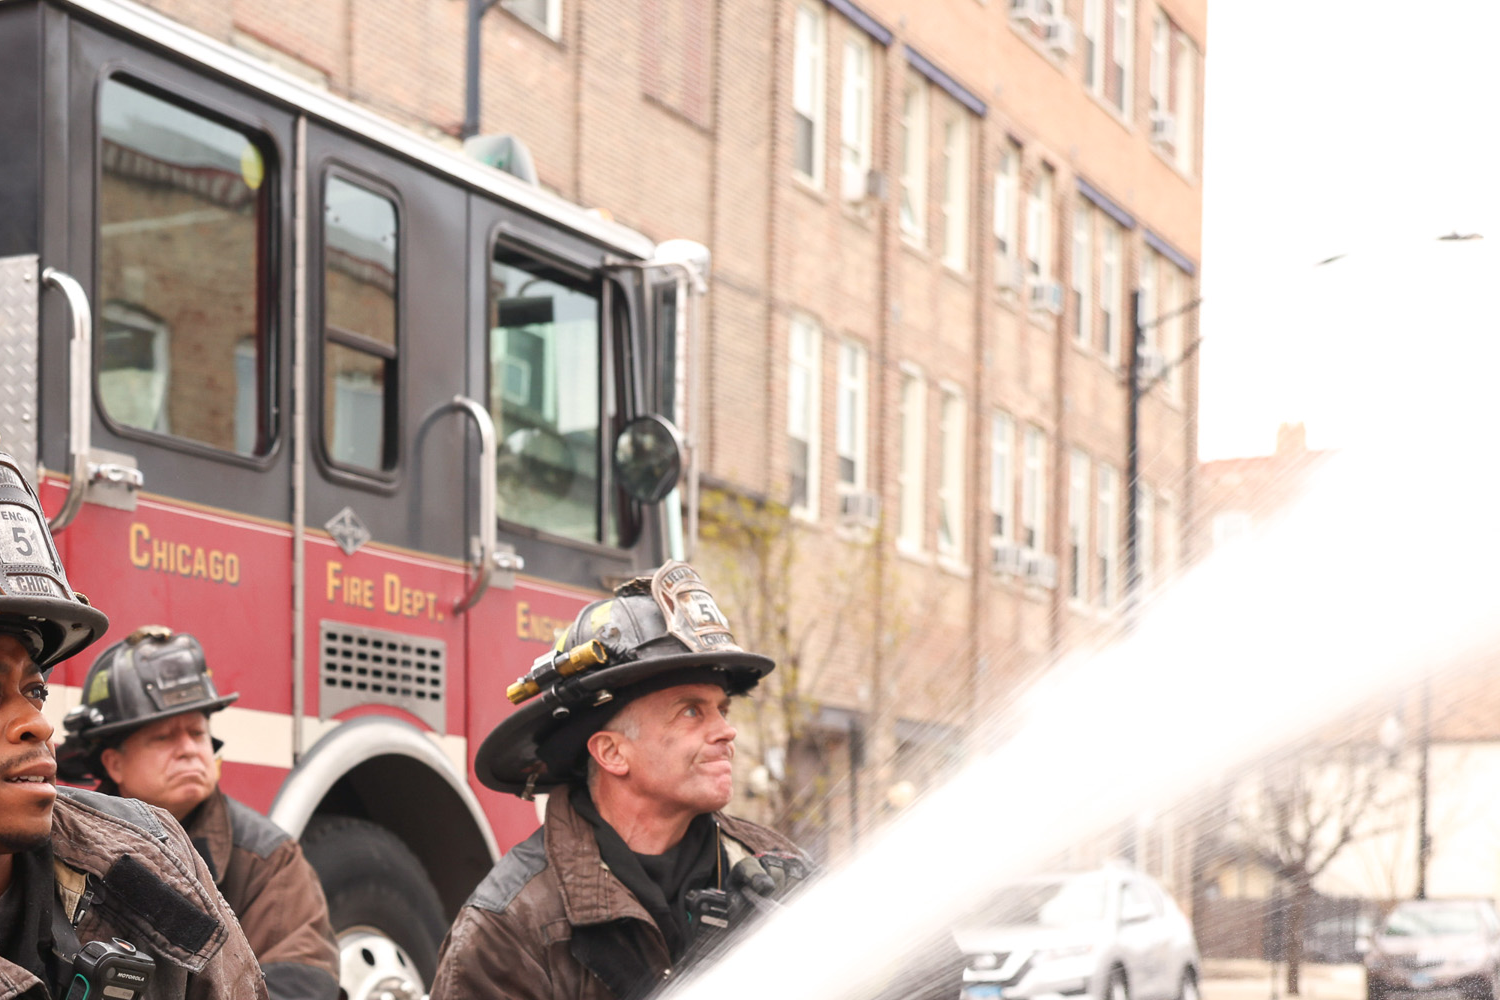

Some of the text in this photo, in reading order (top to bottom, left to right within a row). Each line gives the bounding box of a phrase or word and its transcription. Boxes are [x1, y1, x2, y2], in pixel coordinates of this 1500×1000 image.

[129, 522, 240, 586] CHICAGO
[326, 560, 376, 611] FIRE
[117, 972, 146, 982] MOTOROLA
